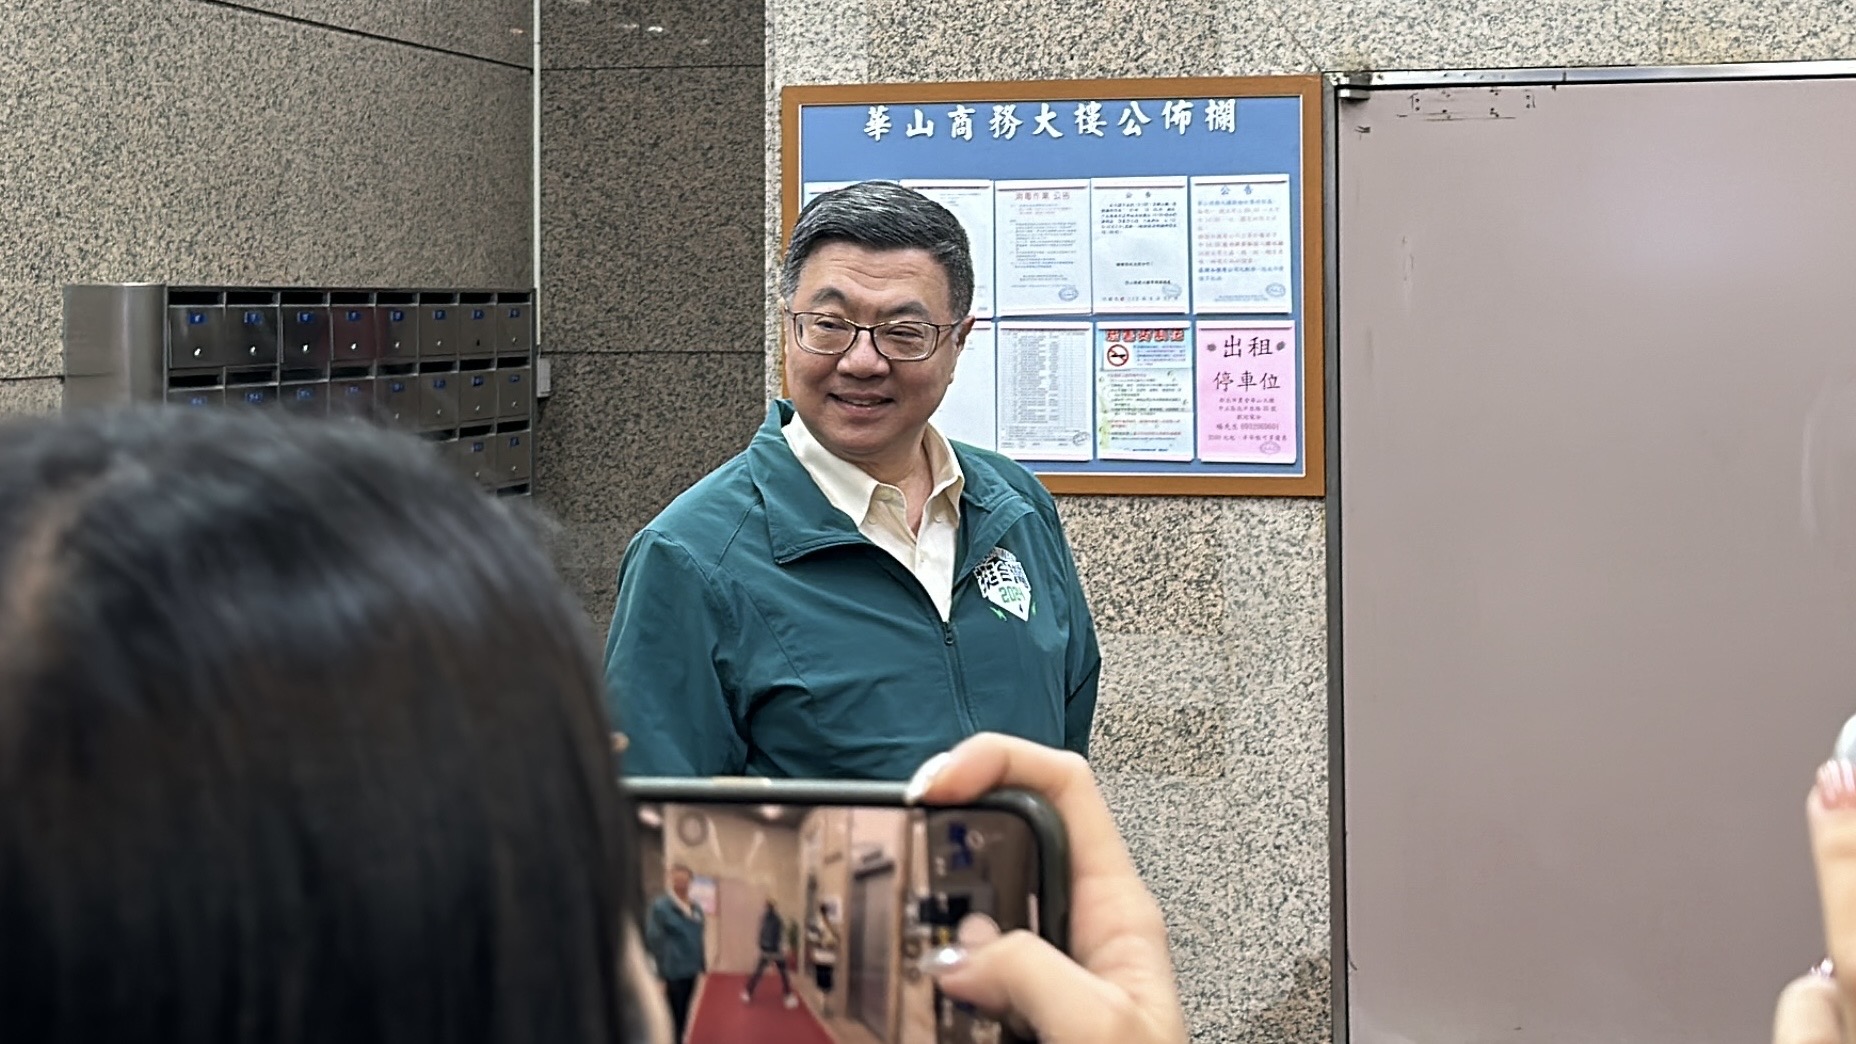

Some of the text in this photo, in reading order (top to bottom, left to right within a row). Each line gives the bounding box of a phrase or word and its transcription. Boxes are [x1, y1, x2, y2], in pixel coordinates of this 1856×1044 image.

[863, 98, 1237, 141] 華山商務大樓公佈欄
[1220, 184, 1253, 195] 公告
[1223, 334, 1274, 358] 出租
[1212, 370, 1281, 392] 停車位
